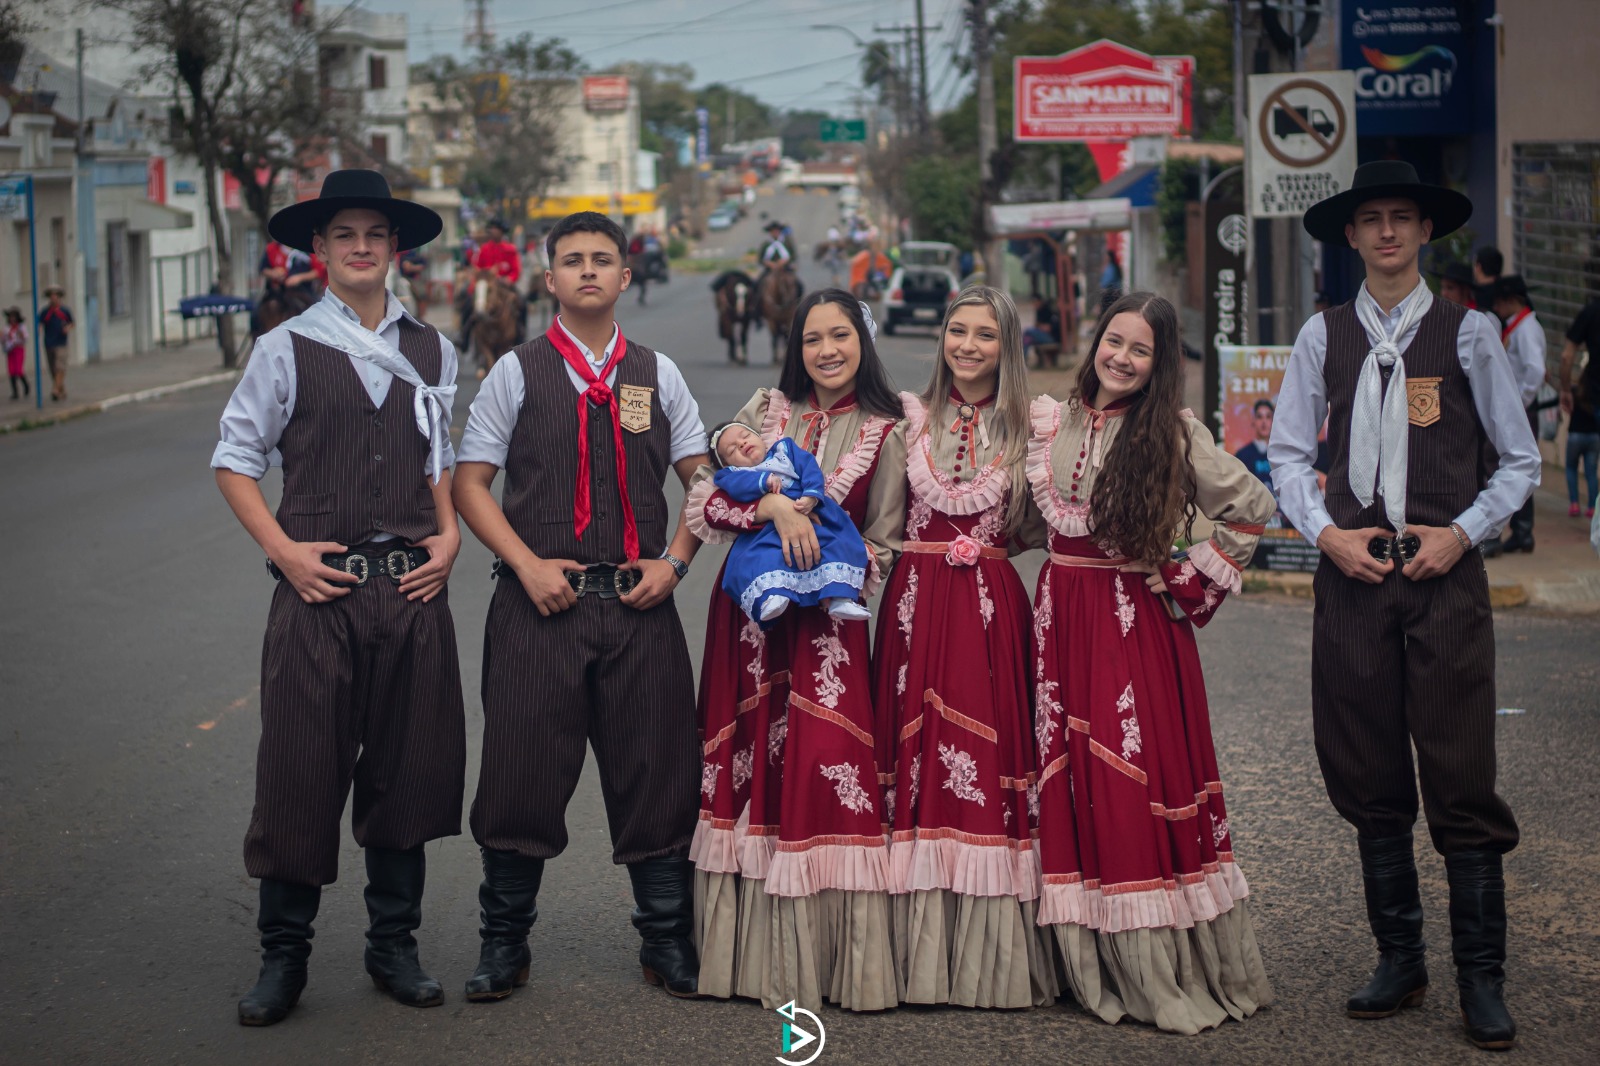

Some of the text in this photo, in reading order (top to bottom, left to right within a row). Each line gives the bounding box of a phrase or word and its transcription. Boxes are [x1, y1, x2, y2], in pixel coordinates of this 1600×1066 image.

[1355, 67, 1441, 97] Coral
[1034, 85, 1170, 104] SANMARTIN
[1277, 172, 1332, 181] PROIBIDO
[1263, 183, 1272, 193] O
[1261, 193, 1276, 203] DE
[1214, 269, 1236, 348] Pereira
[1231, 378, 1270, 393] 22H
[628, 399, 643, 409] ATC
